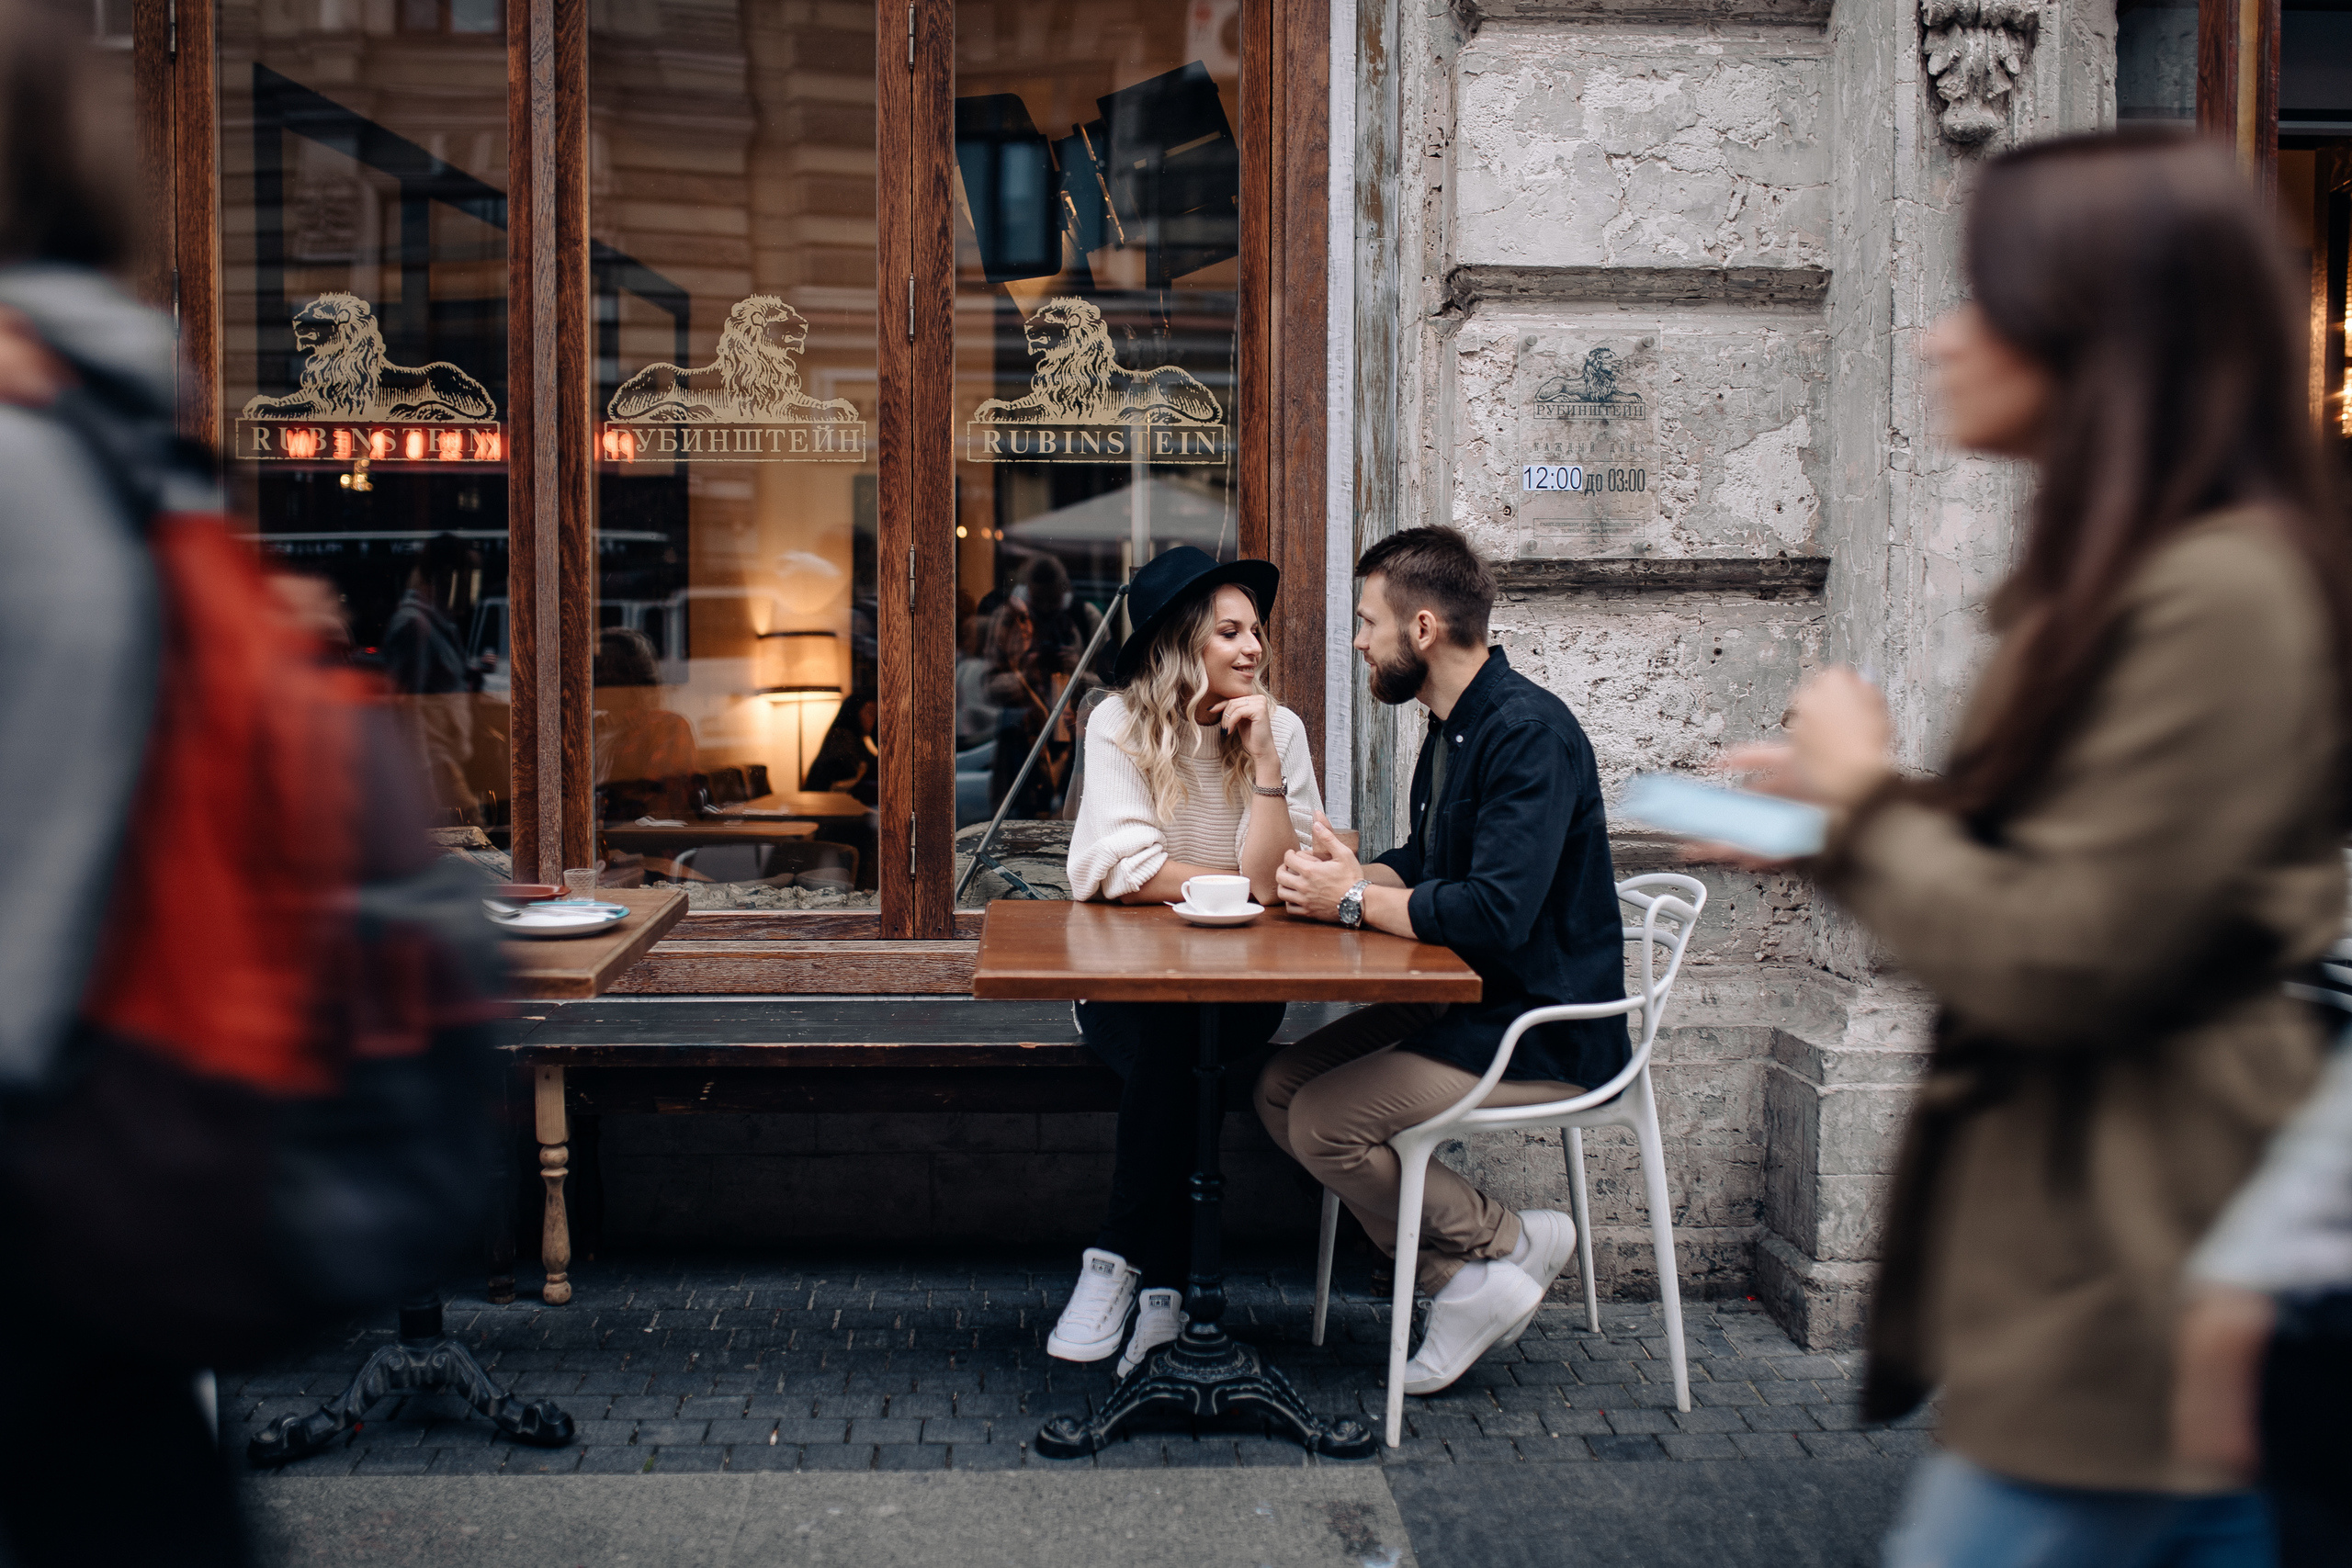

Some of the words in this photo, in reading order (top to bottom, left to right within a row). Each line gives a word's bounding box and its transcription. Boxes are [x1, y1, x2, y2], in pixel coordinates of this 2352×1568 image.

[1536, 404, 1643, 416] РУБИНШТЕЙН
[982, 429, 1217, 455] RUBINSTEIN
[1524, 467, 1582, 489] 12:00
[1584, 474, 1603, 496] до
[1608, 468, 1645, 491] 03:00
